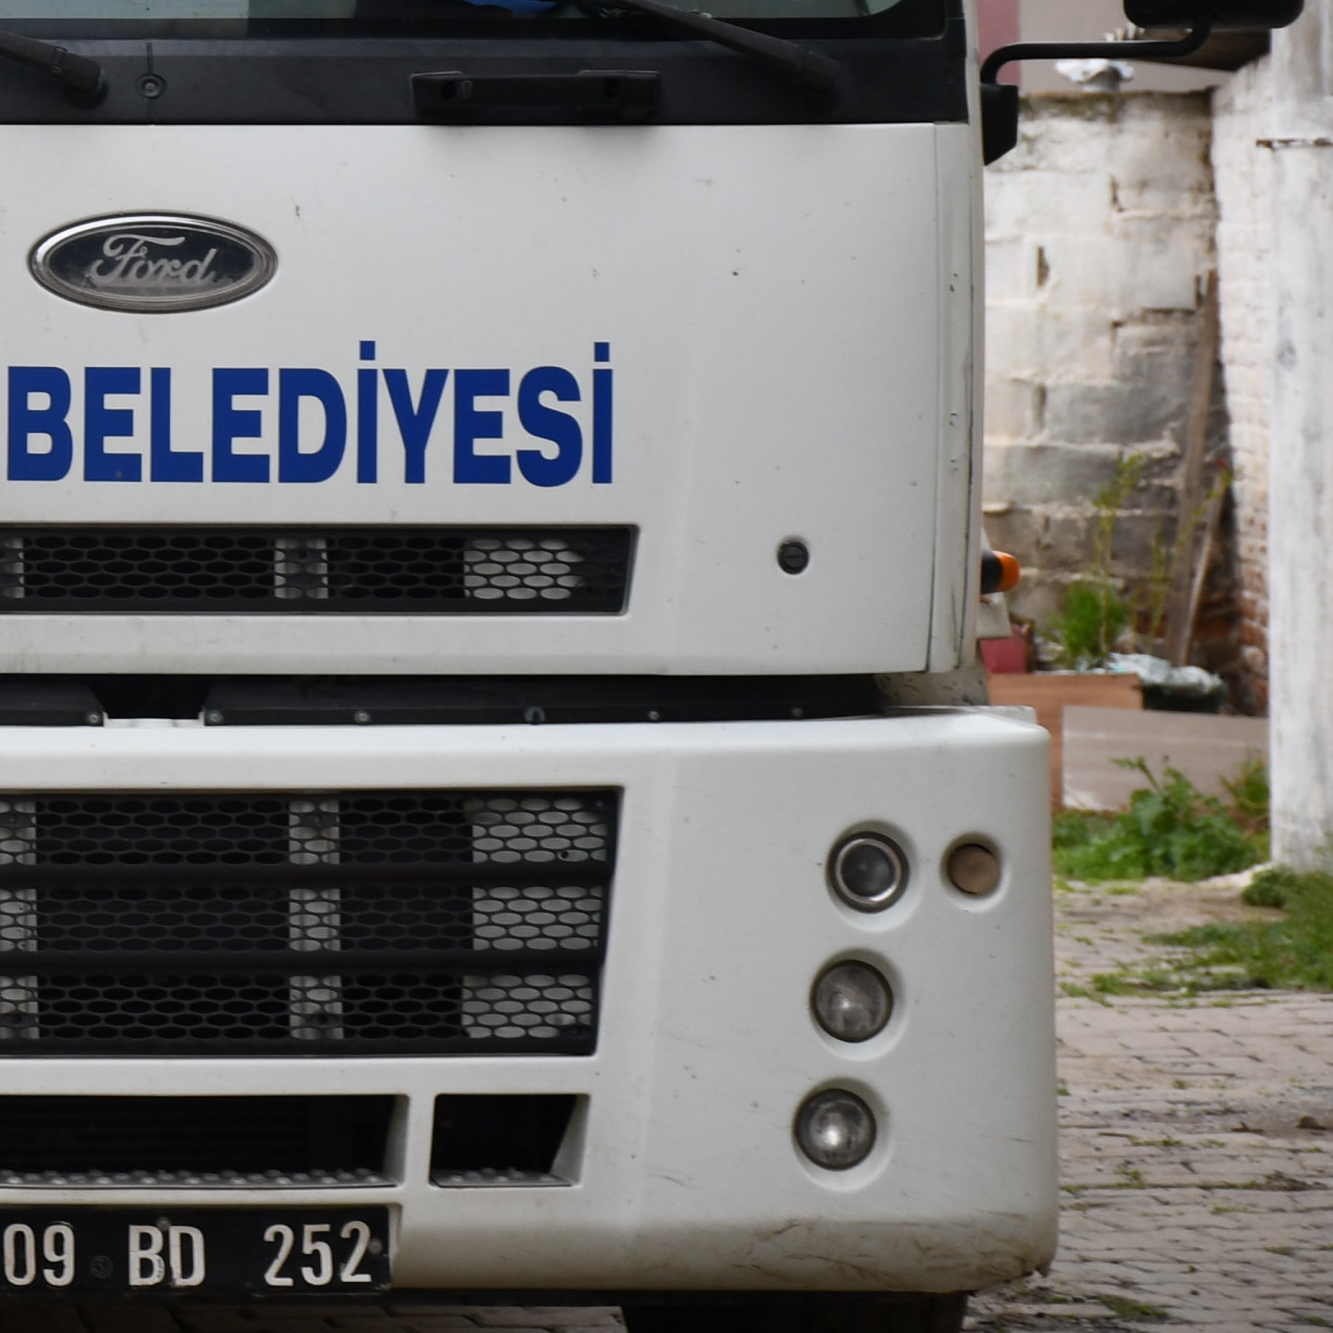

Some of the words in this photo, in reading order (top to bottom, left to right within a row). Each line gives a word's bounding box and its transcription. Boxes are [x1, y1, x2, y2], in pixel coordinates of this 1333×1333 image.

[87, 233, 217, 286] Ford
[7, 341, 615, 489] BELEDİYESİ
[3, 1223, 76, 1286] 09
[128, 1224, 207, 1287] BD
[263, 1220, 373, 1286] 252
